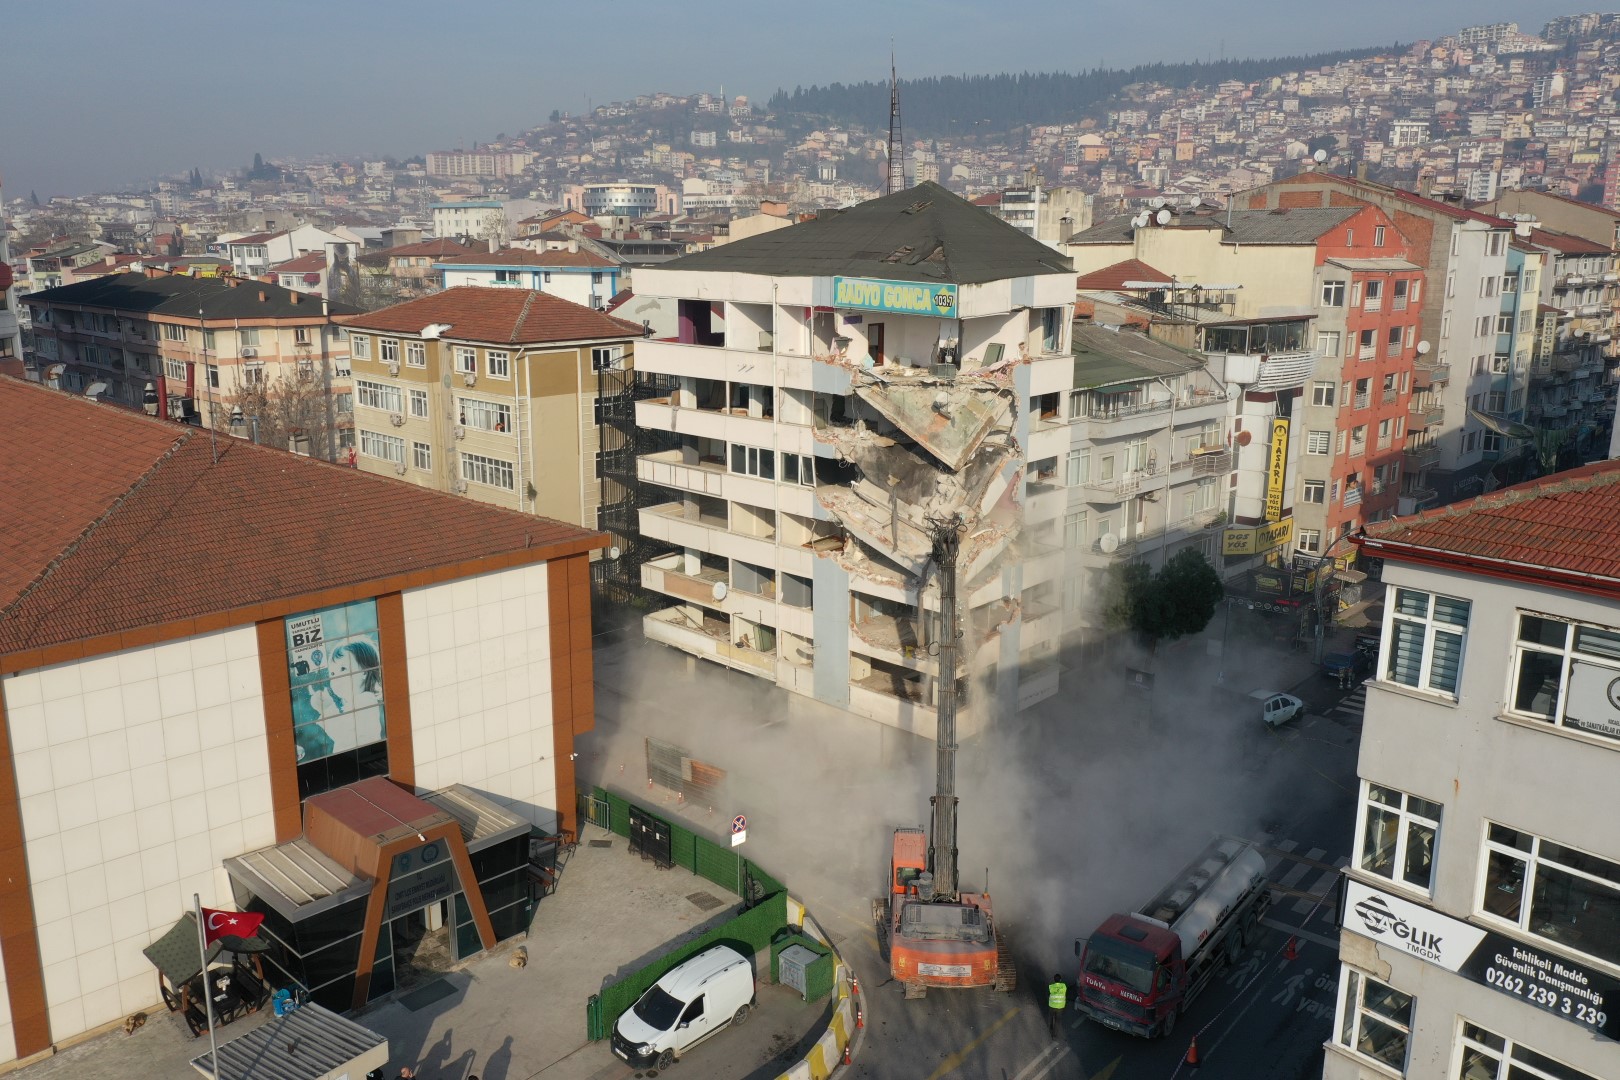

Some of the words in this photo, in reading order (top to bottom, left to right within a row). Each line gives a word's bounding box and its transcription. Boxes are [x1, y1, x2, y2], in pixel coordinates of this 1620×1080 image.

[837, 282, 880, 306] RADYO
[884, 286, 932, 311] GONCA
[934, 294, 954, 308] 103.7
[1274, 438, 1282, 484] TASARI
[1266, 524, 1289, 542] TASARI
[291, 618, 319, 629] UMUTLU
[293, 629, 322, 647] BiZ
[1364, 908, 1443, 954] SAĞLIK
[1406, 942, 1441, 962] TMGDK
[1512, 947, 1551, 970] Tehlikeli
[1554, 963, 1588, 985] Madde
[1495, 954, 1536, 978] Güvenlik
[1538, 970, 1603, 1005] Danışmanlığı
[1486, 967, 1524, 994] 0262
[1528, 984, 1557, 1007] 239
[1561, 998, 1571, 1014] 3
[1576, 1004, 1607, 1028] 239
